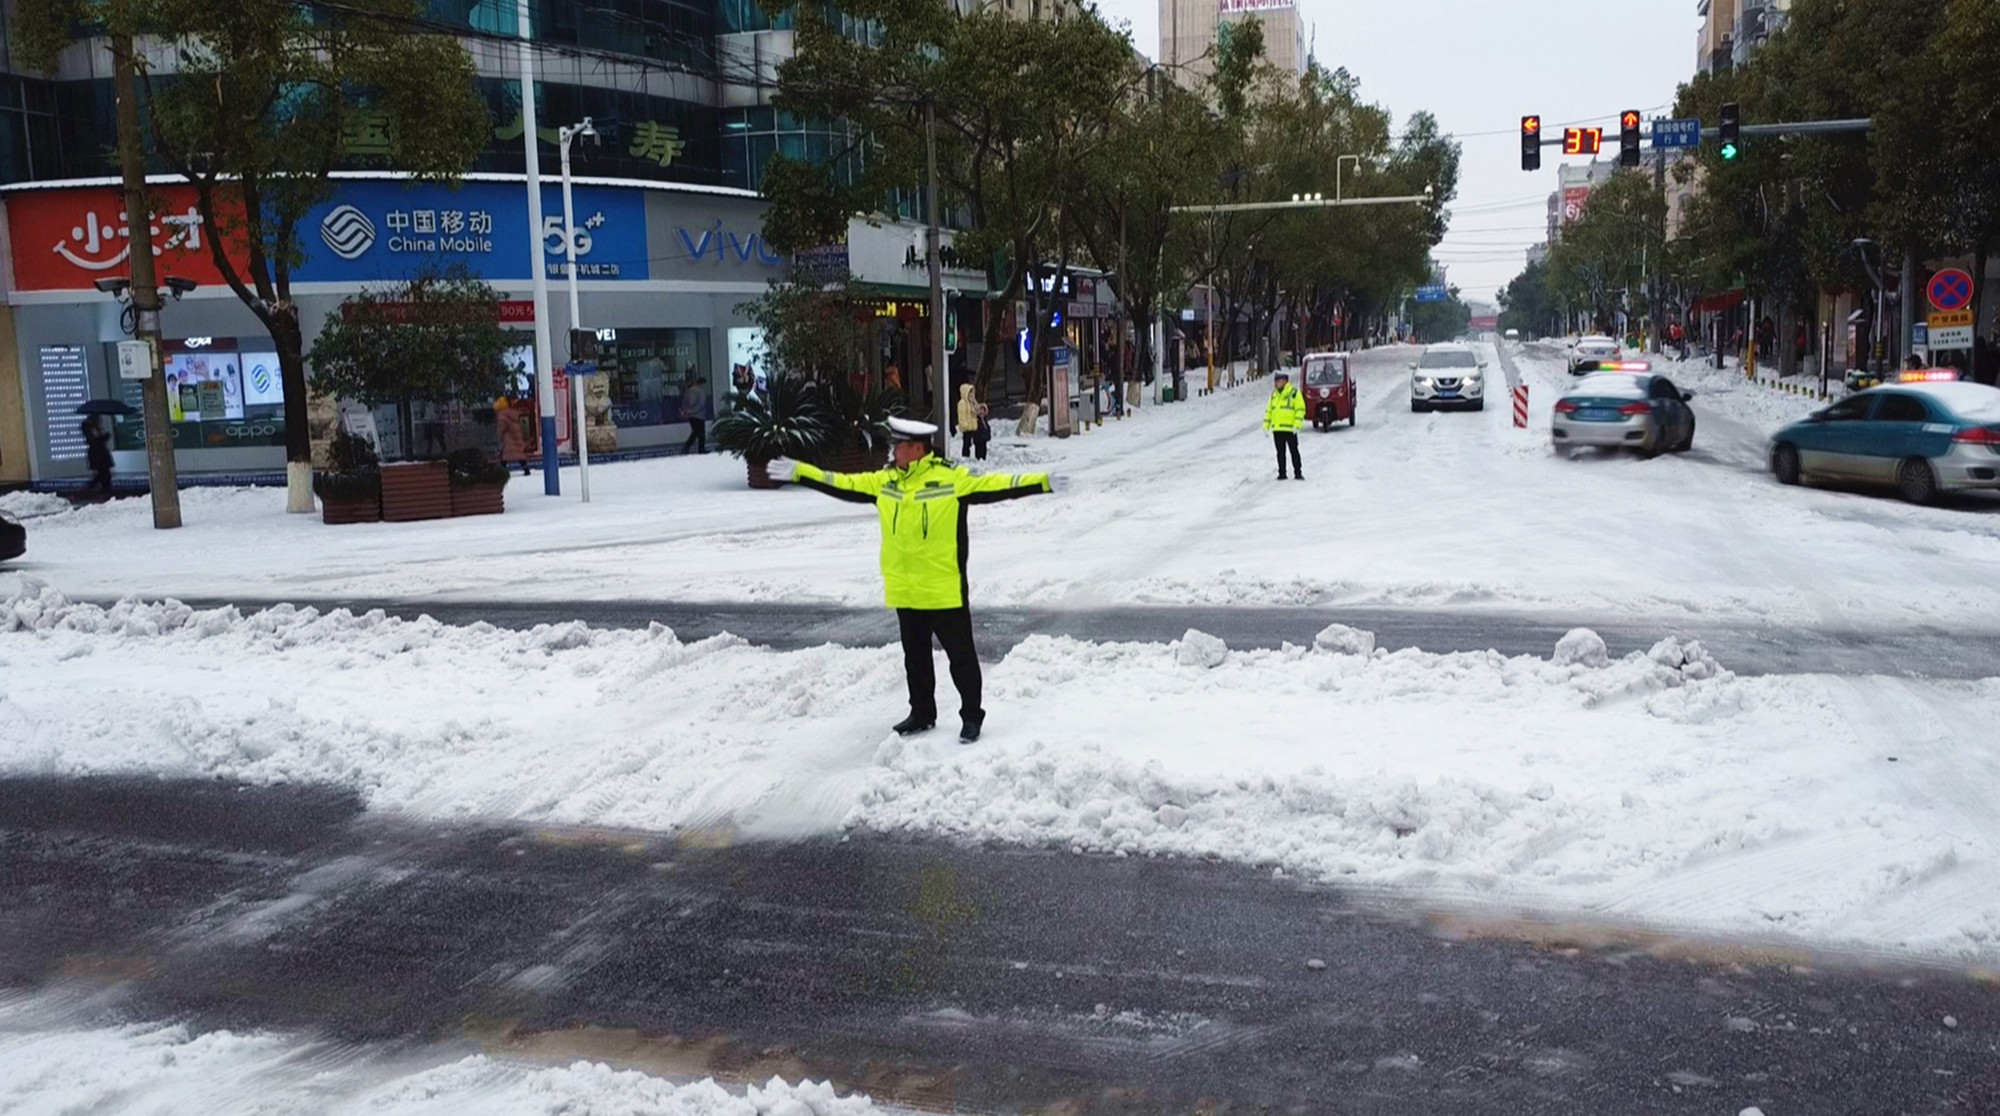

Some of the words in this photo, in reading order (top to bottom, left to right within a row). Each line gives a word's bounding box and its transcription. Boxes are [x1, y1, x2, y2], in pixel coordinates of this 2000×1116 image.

[1566, 127, 1600, 153] 37
[386, 209, 492, 234] 中国移动
[388, 236, 436, 252] China
[439, 236, 492, 252] Mobile
